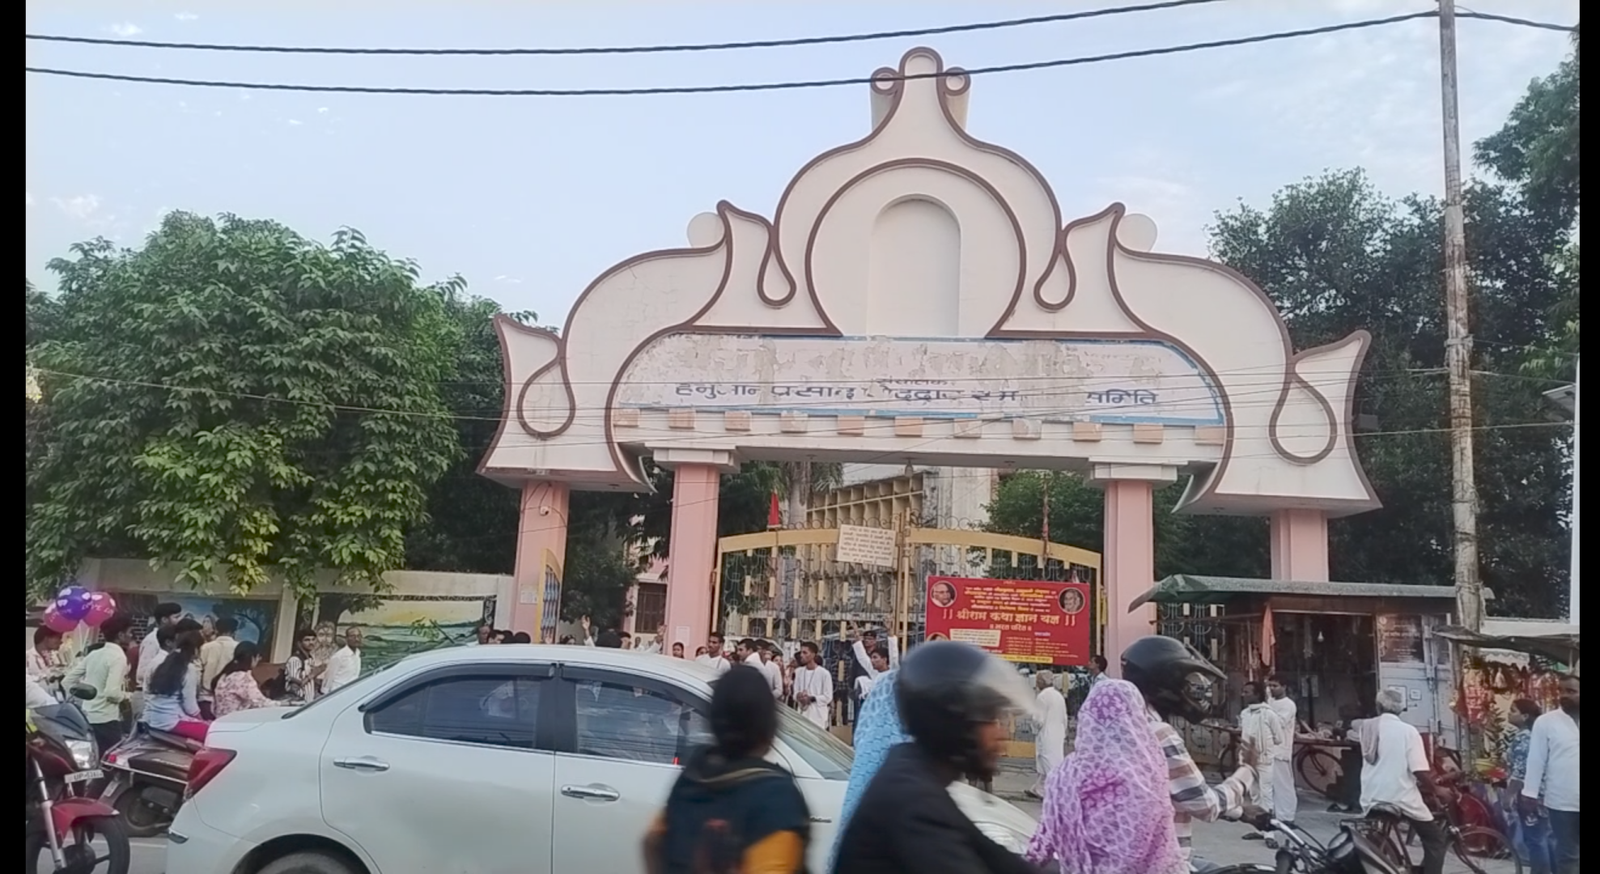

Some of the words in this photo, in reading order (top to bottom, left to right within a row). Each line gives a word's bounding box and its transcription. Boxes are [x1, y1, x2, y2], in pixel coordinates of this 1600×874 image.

[956, 607, 987, 622] श्रीराम
[989, 611, 1013, 623] कथा
[1015, 612, 1038, 624] ज्ञान
